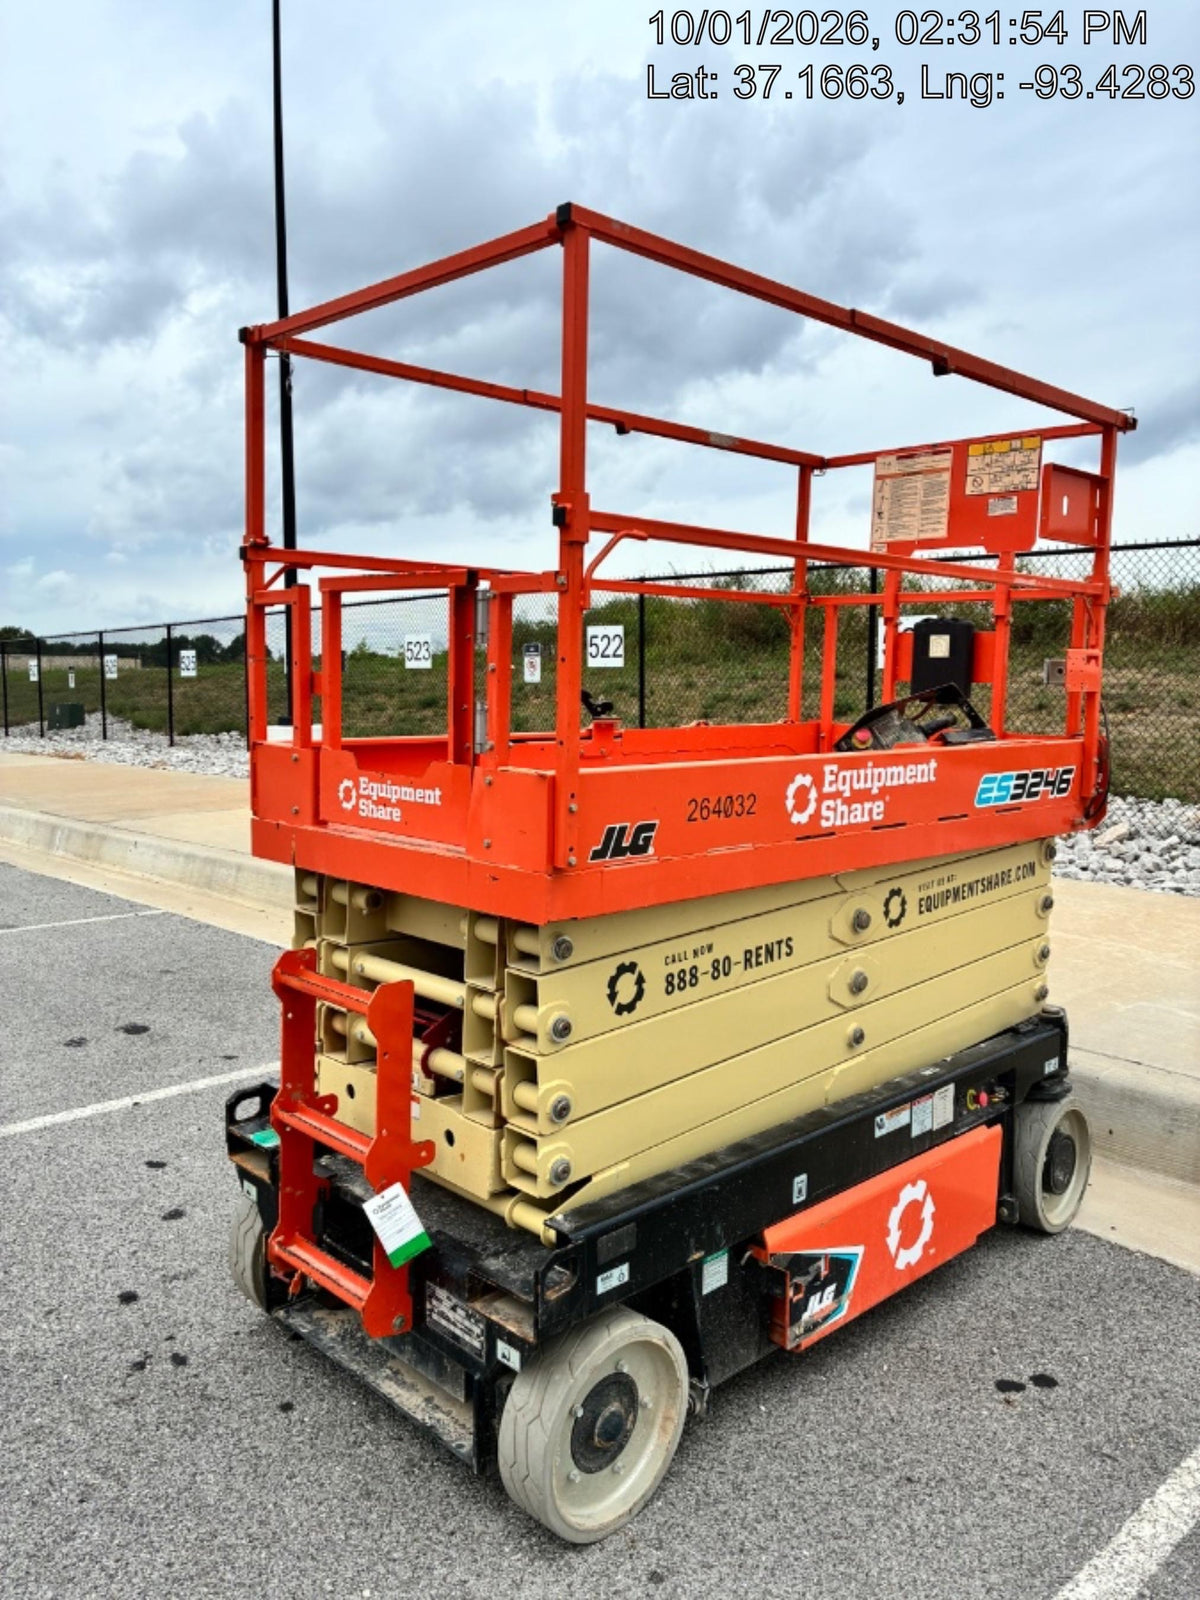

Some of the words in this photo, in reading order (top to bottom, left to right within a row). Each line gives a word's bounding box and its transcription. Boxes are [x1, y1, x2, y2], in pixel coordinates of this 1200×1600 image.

[407, 641, 431, 661] 523
[590, 634, 623, 658] 522
[359, 777, 442, 806] Equipment
[822, 758, 938, 797] Equipment
[975, 766, 1076, 808] ES3246
[358, 798, 401, 822] Share
[687, 793, 757, 822] 264032
[820, 798, 884, 828] Share
[588, 820, 659, 862] JLG
[918, 861, 1036, 915] EQUIPMENTSHARE.COM
[664, 950, 688, 967] CALL
[692, 942, 714, 959] NOW
[664, 936, 794, 996] 888-80-RENTS
[802, 1282, 837, 1320] JLG
